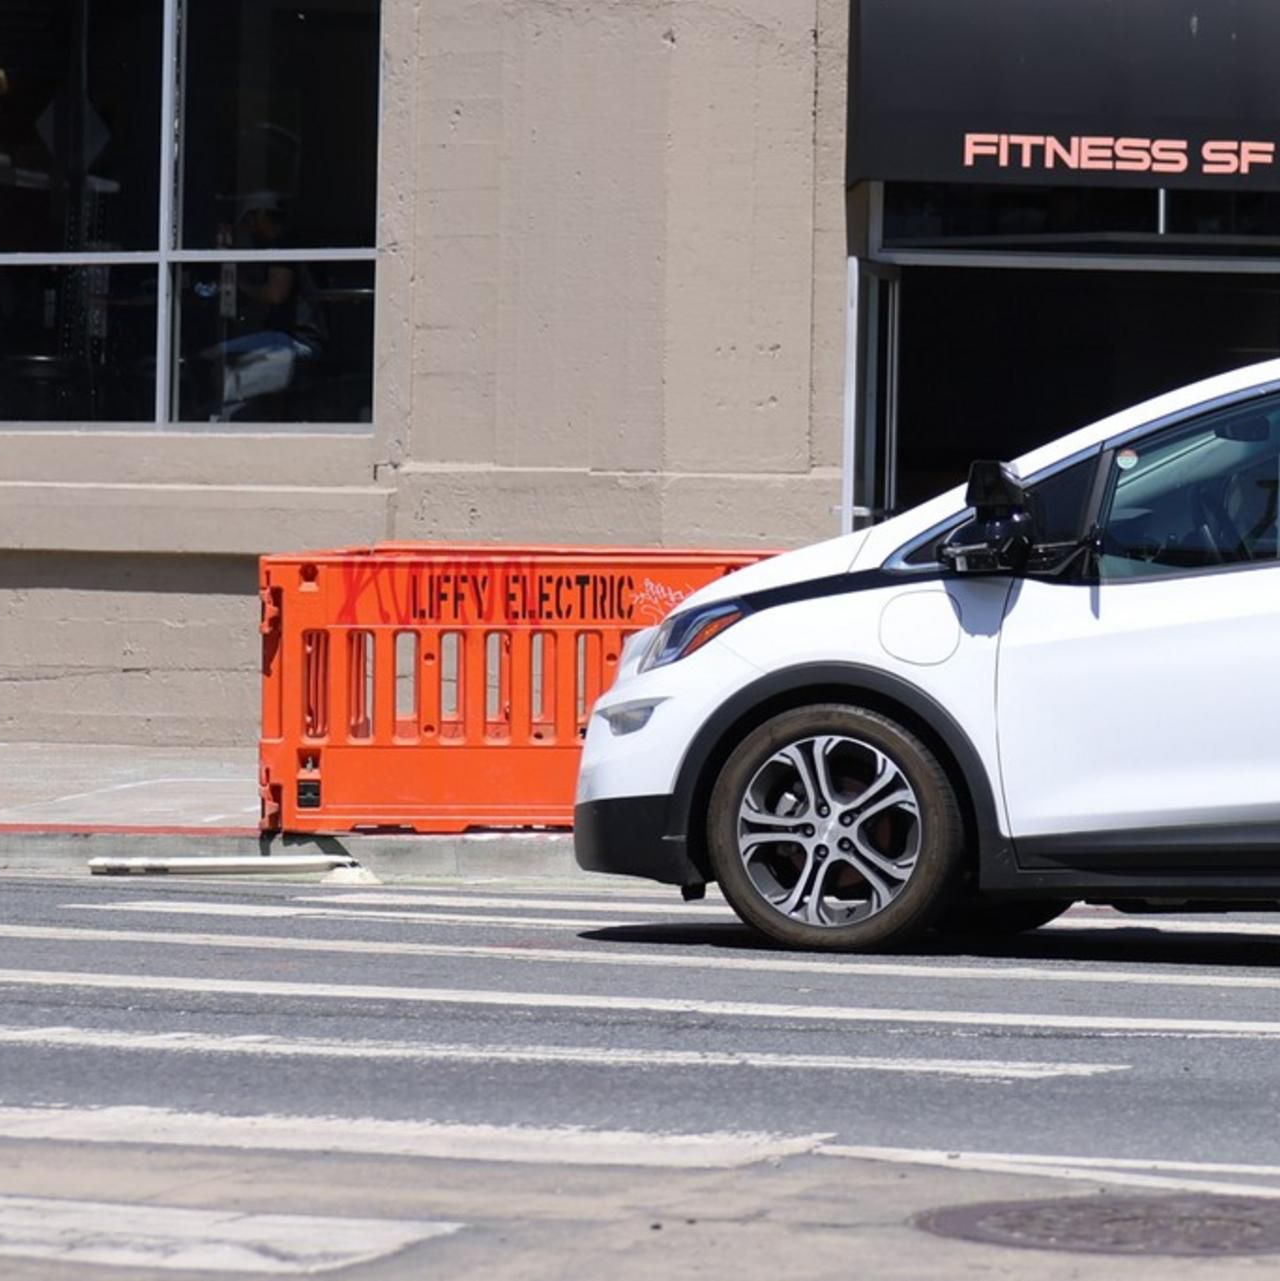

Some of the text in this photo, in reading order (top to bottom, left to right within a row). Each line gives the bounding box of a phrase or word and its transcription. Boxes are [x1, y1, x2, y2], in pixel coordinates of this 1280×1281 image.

[964, 133, 1276, 175] FITNESS SF
[412, 575, 489, 620] LIFFY
[505, 575, 634, 620] ELECTRIC
